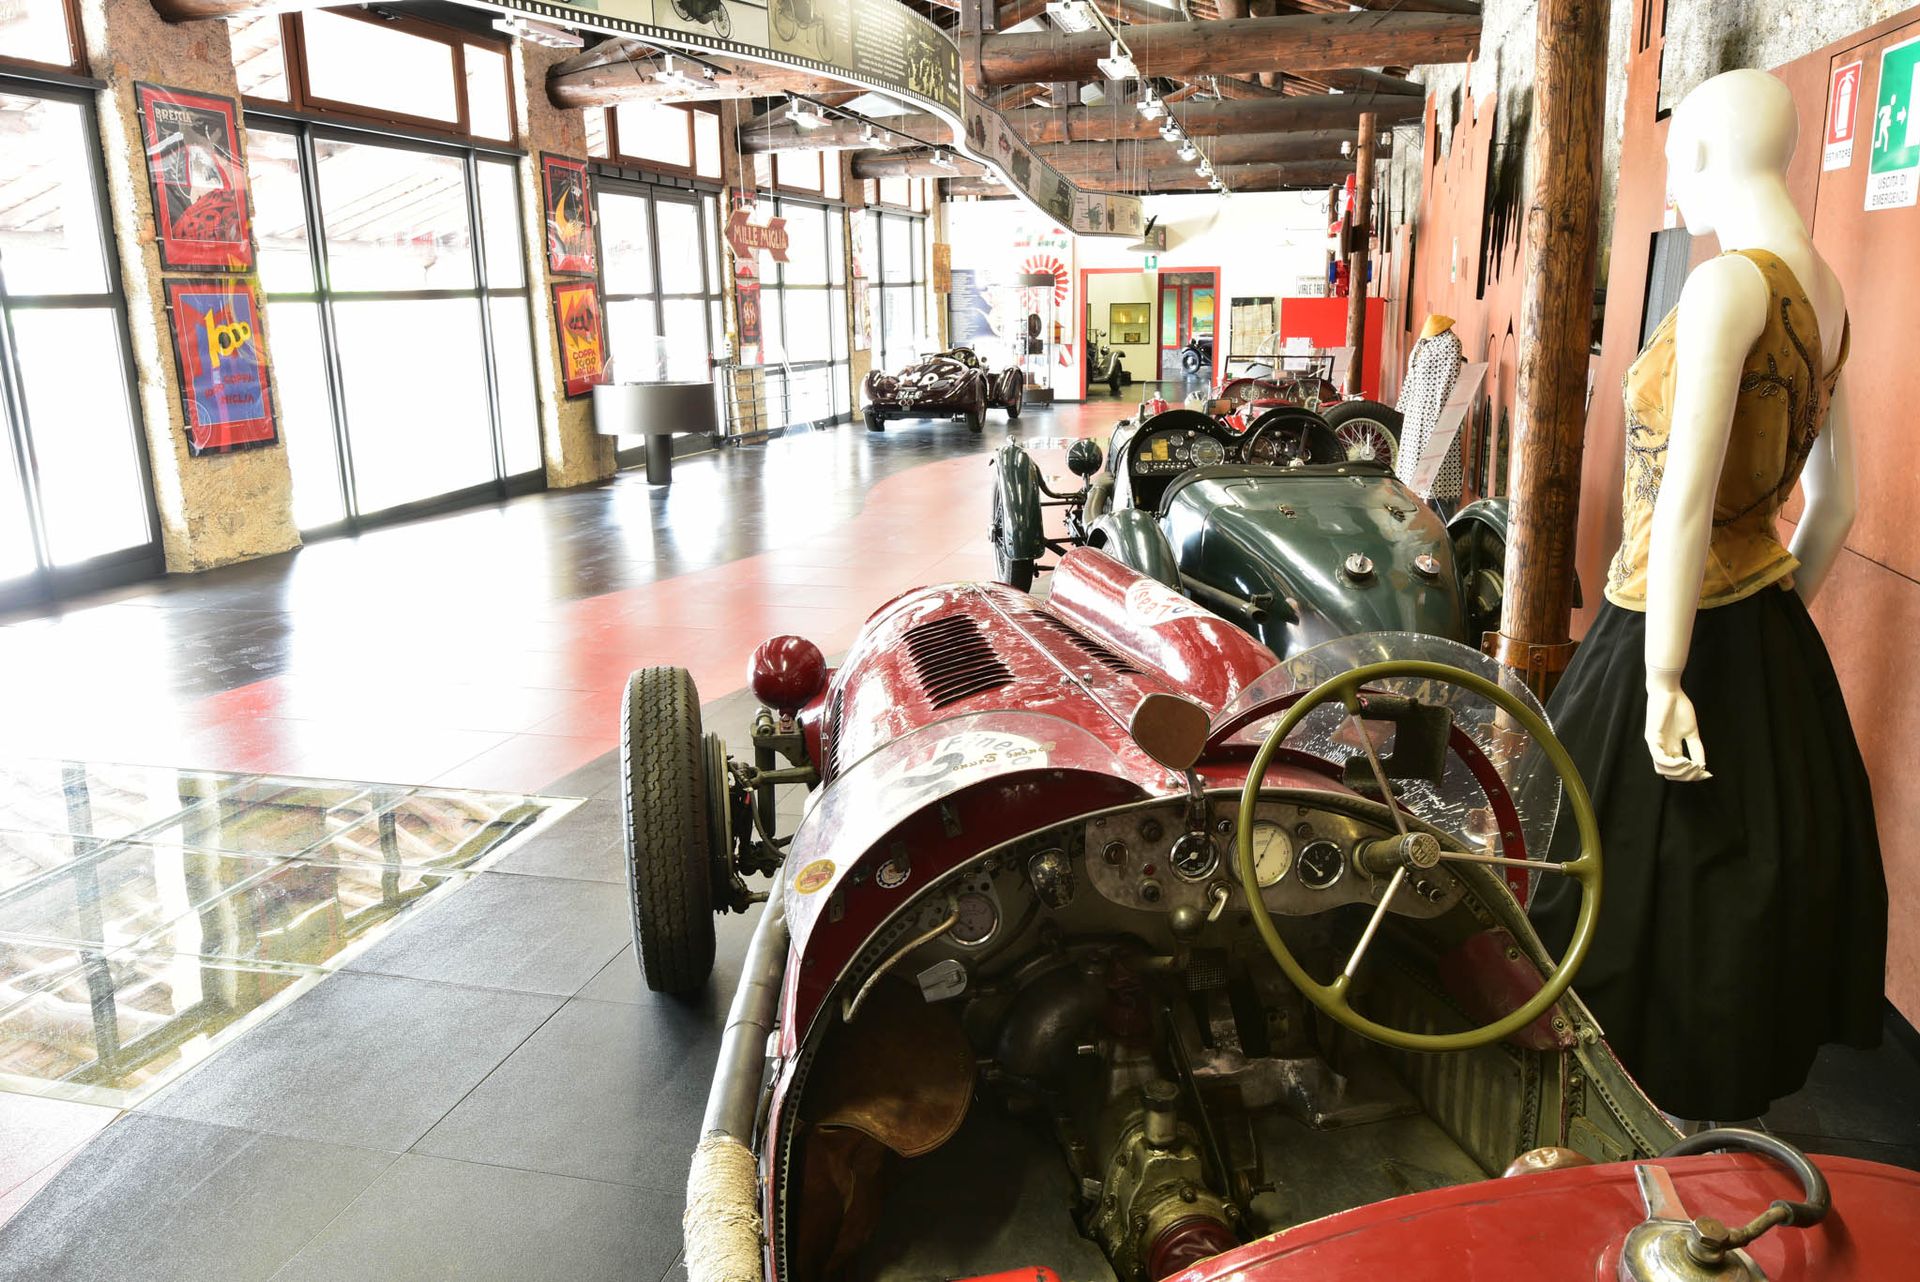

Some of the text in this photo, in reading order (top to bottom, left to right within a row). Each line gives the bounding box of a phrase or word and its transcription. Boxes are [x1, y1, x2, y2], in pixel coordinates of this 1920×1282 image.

[154, 107, 193, 123] BRESCIA
[1877, 173, 1908, 190] USCITA DI
[733, 225, 787, 249] MILLE MIGLIA
[743, 301, 756, 325] 88
[572, 348, 597, 360] COPPA
[574, 356, 597, 369] 1000
